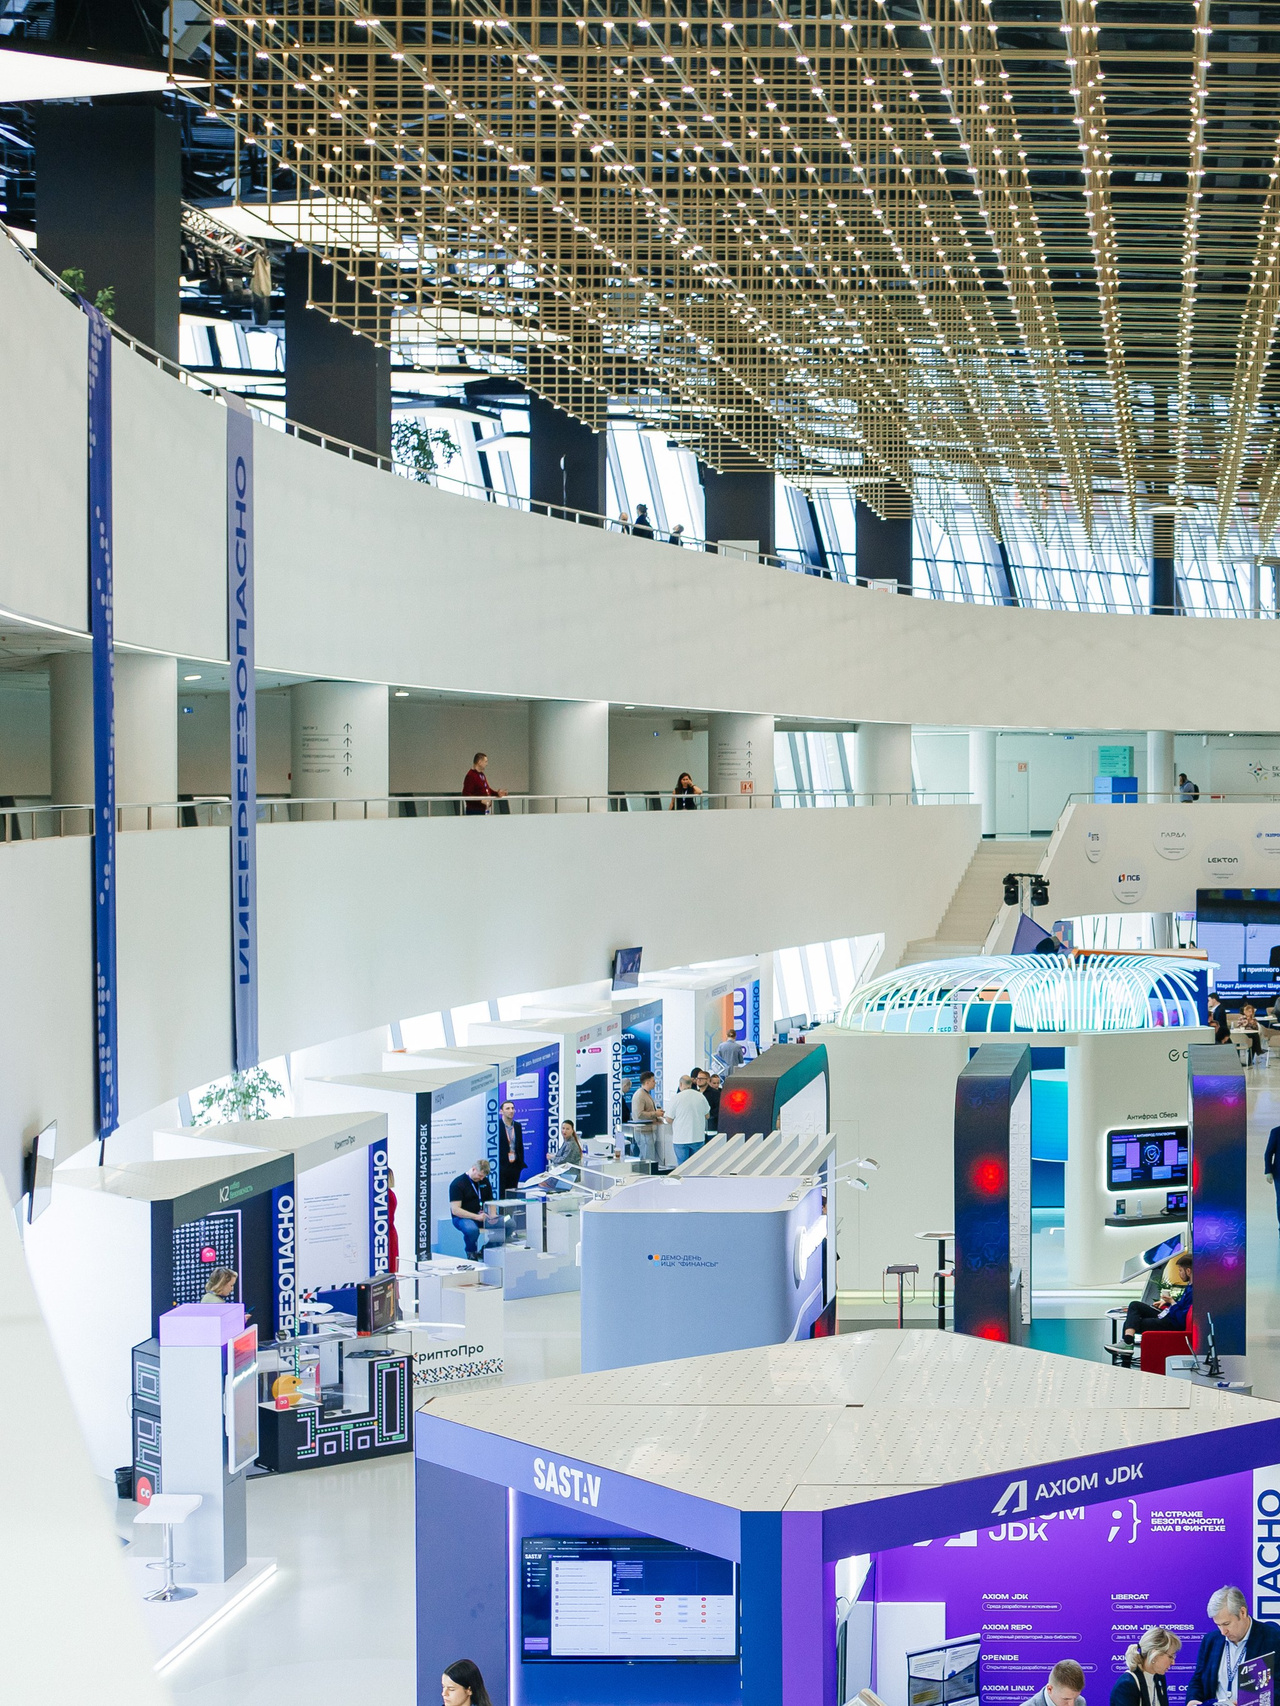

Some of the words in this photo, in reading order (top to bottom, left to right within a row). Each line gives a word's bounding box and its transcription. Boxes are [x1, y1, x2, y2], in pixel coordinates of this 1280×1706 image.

[1127, 1113, 1158, 1121] Антифрод
[1159, 1111, 1178, 1119] Сбера
[420, 1124, 428, 1178] НАСТРОЕК
[419, 1180, 427, 1249] БЕЗОПАСНЫХ
[1034, 1472, 1099, 1502] AXIOM
[1104, 1462, 1144, 1487] JDK
[988, 1521, 1049, 1542] JDK
